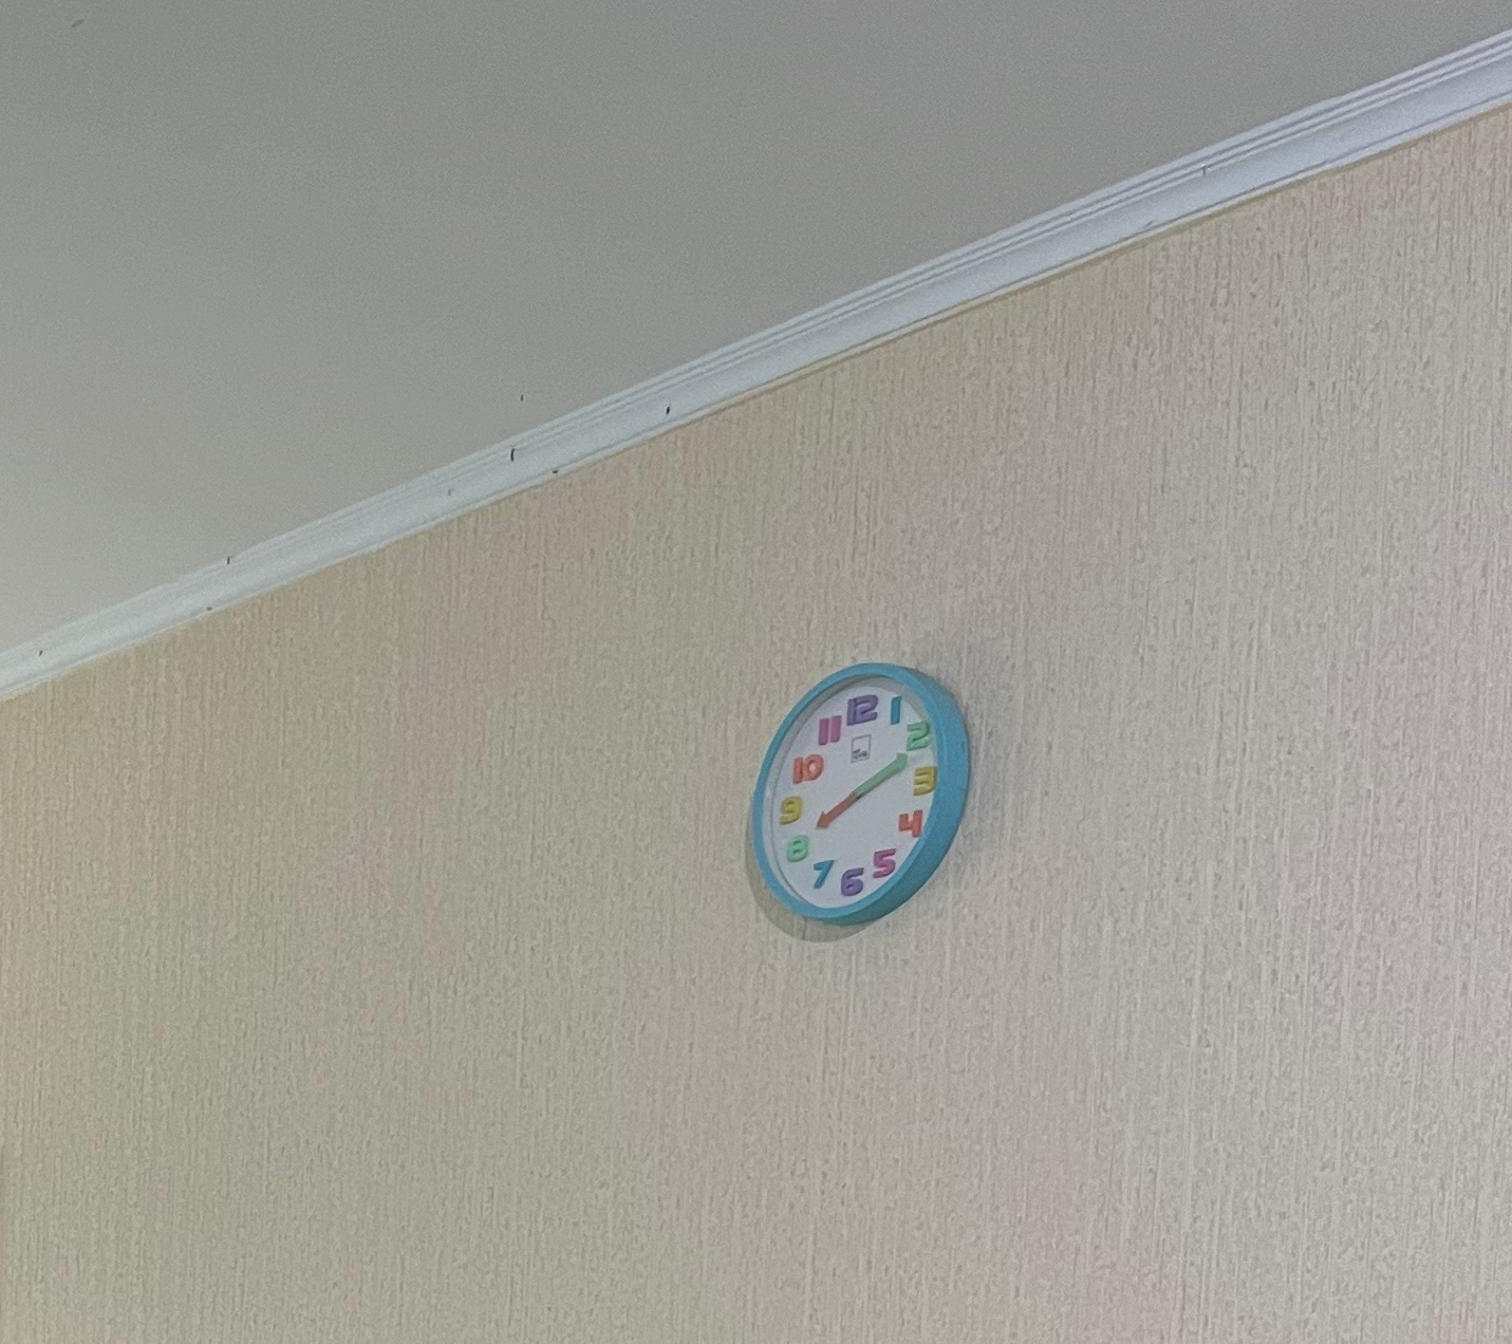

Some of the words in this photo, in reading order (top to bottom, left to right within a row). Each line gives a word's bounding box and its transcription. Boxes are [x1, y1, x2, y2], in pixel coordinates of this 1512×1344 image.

[846, 694, 879, 727] 12
[890, 696, 902, 725] 1
[818, 715, 842, 746] 11
[906, 721, 931, 751] 2
[793, 754, 824, 784] 10
[912, 766, 937, 796] 3
[779, 795, 803, 825] 9
[898, 809, 923, 838] 4
[787, 834, 810, 862] 8
[813, 859, 835, 889] 7
[872, 848, 896, 879] 5
[840, 867, 865, 896] 6
